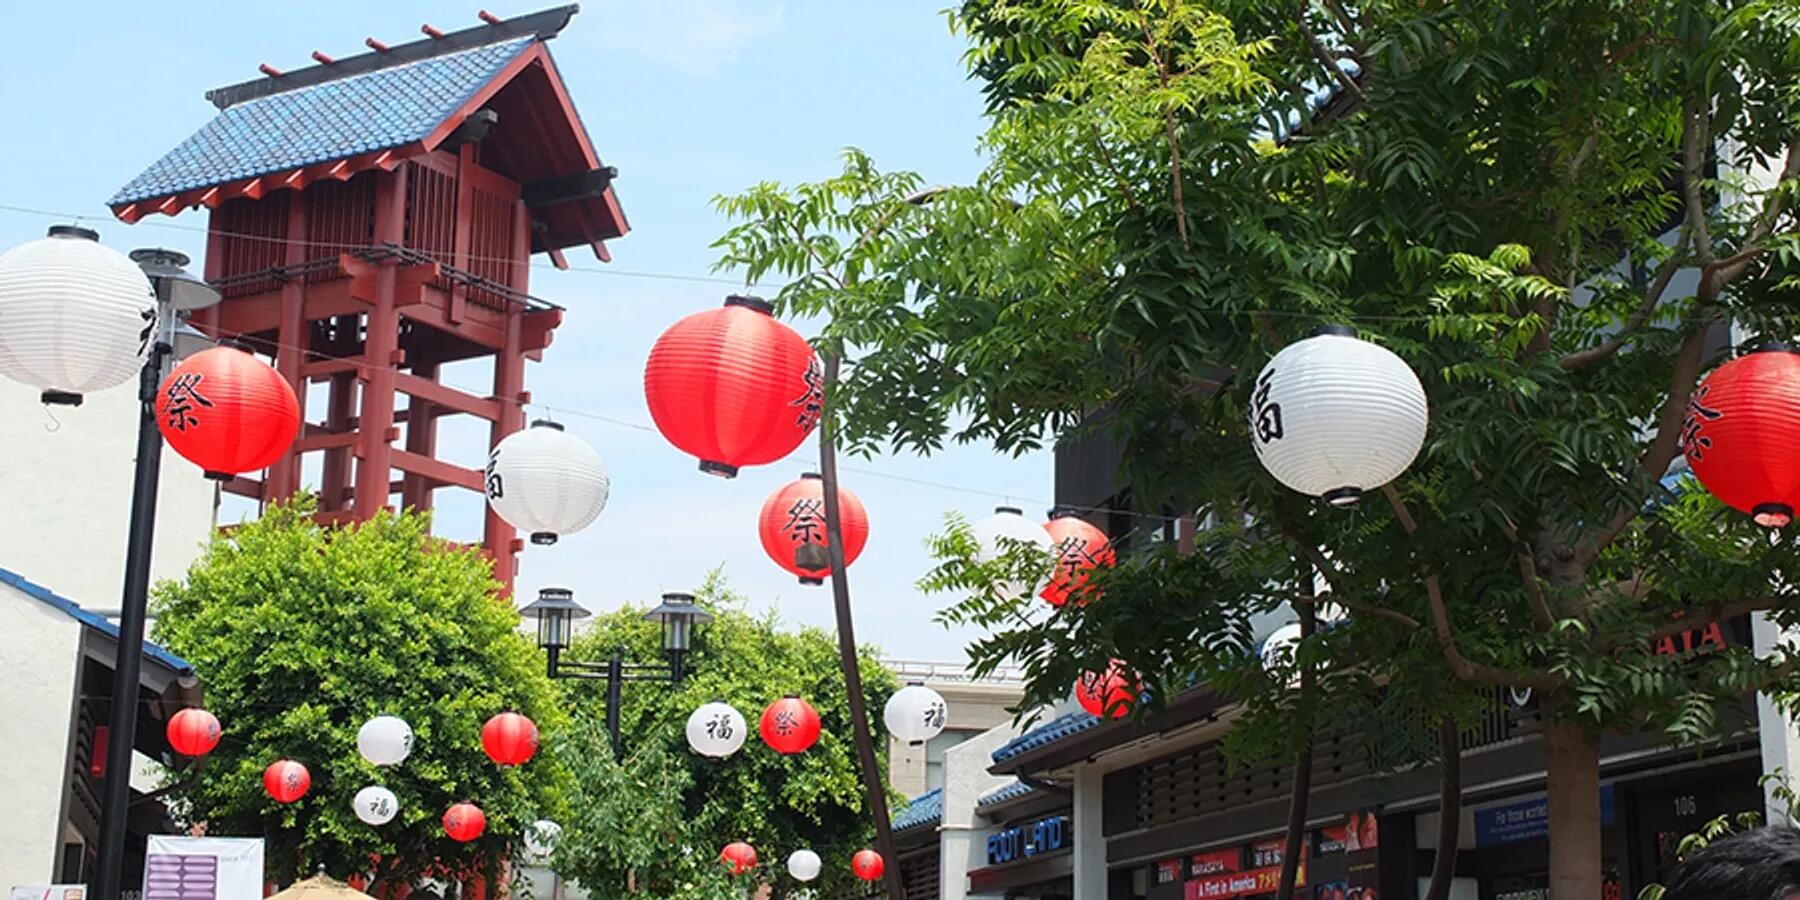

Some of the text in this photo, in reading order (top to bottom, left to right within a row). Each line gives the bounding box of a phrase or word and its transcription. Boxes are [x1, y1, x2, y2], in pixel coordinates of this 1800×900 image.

[163, 373, 213, 431] 祭
[784, 499, 828, 543] 祭
[1056, 536, 1098, 578] 祭
[706, 713, 733, 740] 福
[775, 711, 799, 736] 祭
[924, 702, 946, 729] 福
[1674, 796, 1697, 816] 106
[987, 815, 1063, 864] FOOT LAND
[1230, 875, 1256, 892] America
